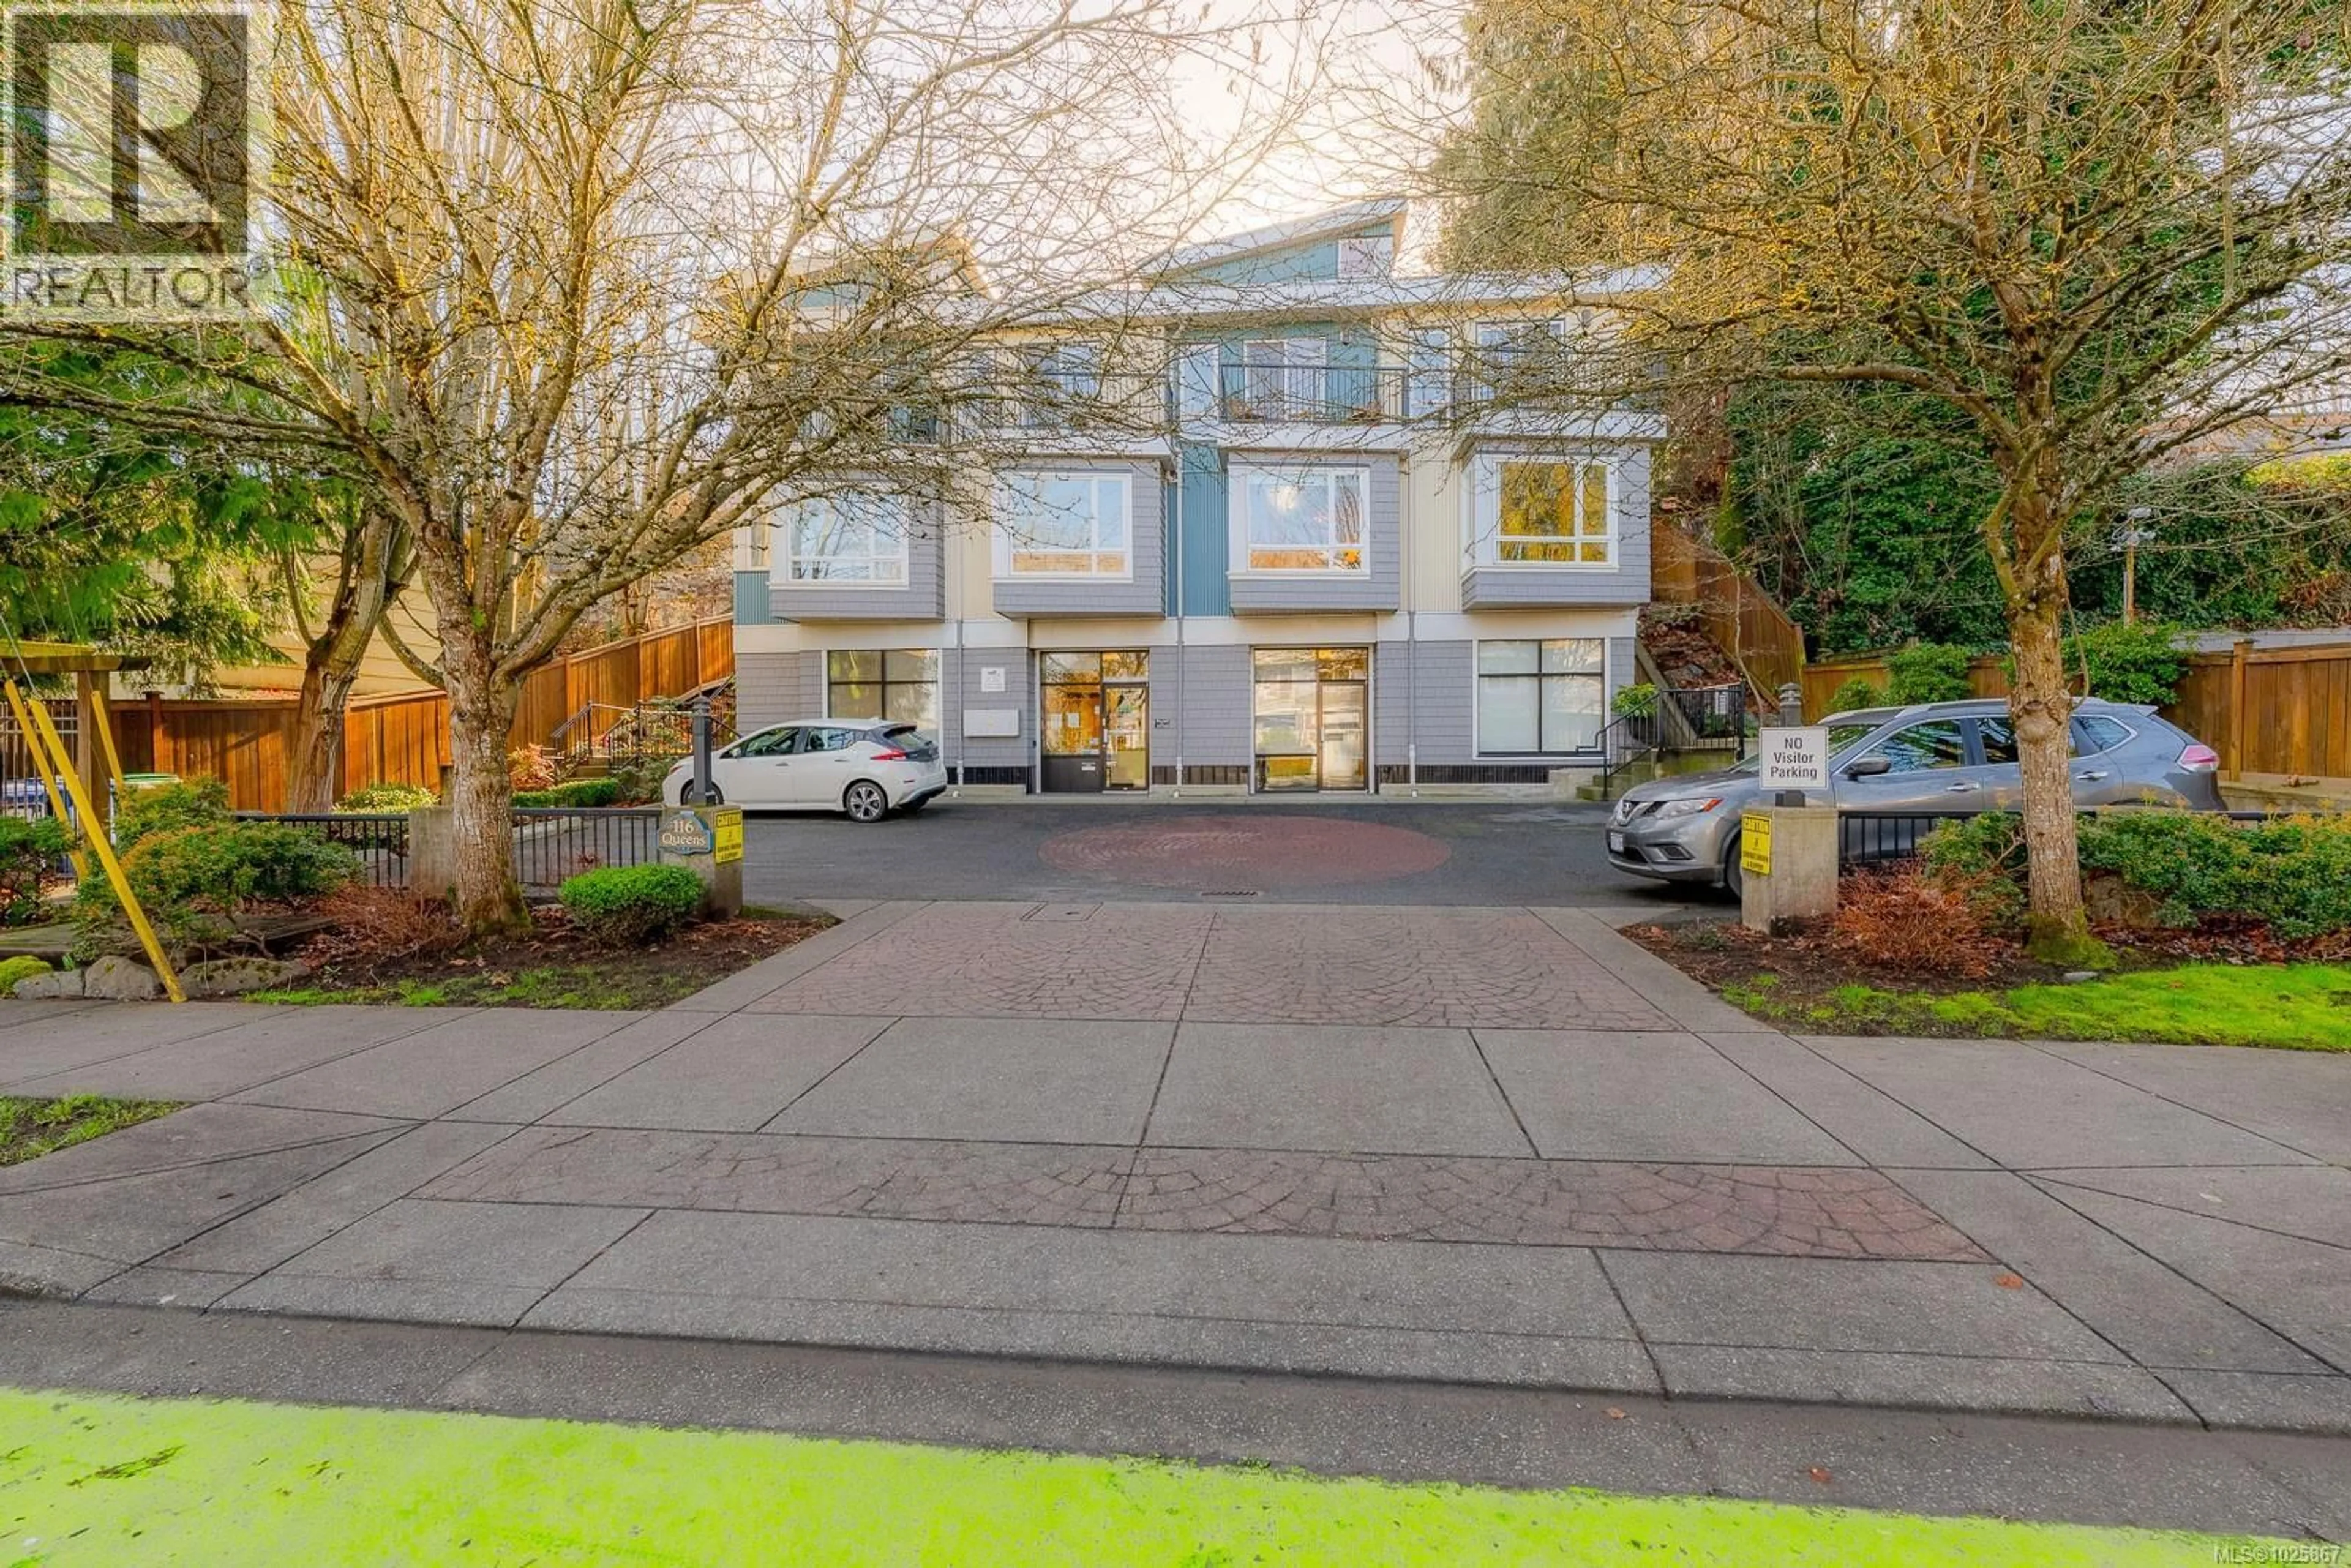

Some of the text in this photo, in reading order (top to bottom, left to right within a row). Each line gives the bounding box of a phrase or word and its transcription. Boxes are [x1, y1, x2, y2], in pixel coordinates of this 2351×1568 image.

[1785, 737, 1802, 749] NO
[1773, 751, 1814, 763] Visitor
[1771, 766, 1817, 780] Parking
[673, 820, 694, 833] 116
[662, 833, 705, 846] Queens
